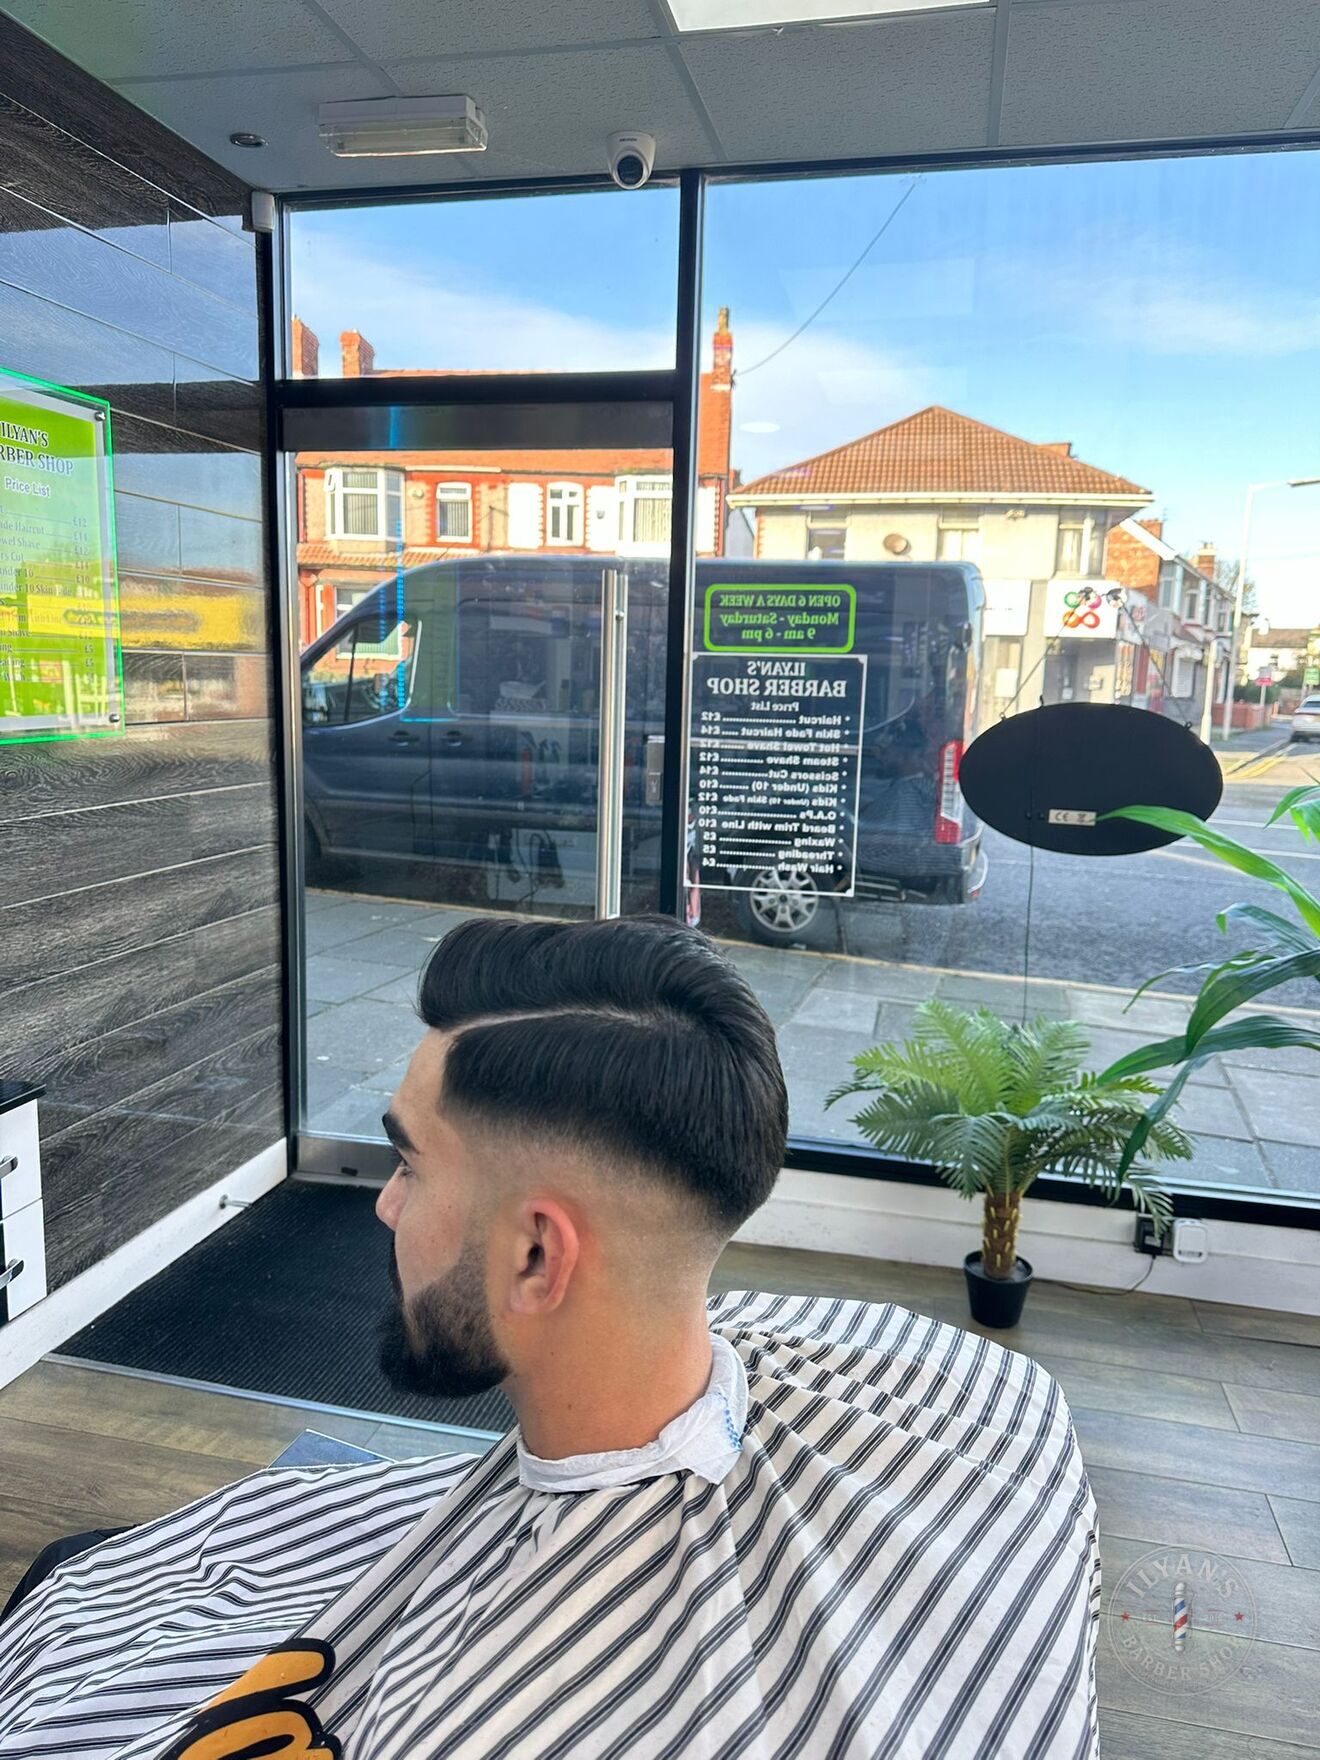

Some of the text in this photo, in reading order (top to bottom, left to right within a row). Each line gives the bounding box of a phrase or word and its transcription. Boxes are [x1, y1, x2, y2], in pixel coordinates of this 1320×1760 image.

[1, 421, 48, 447] ILYAN'S
[38, 453, 73, 475] SHOP
[5, 477, 50, 497] Price List
[15, 521, 45, 535] Haircut
[0, 536, 16, 546] wel
[0, 566, 21, 577] nder
[0, 582, 22, 592] nder
